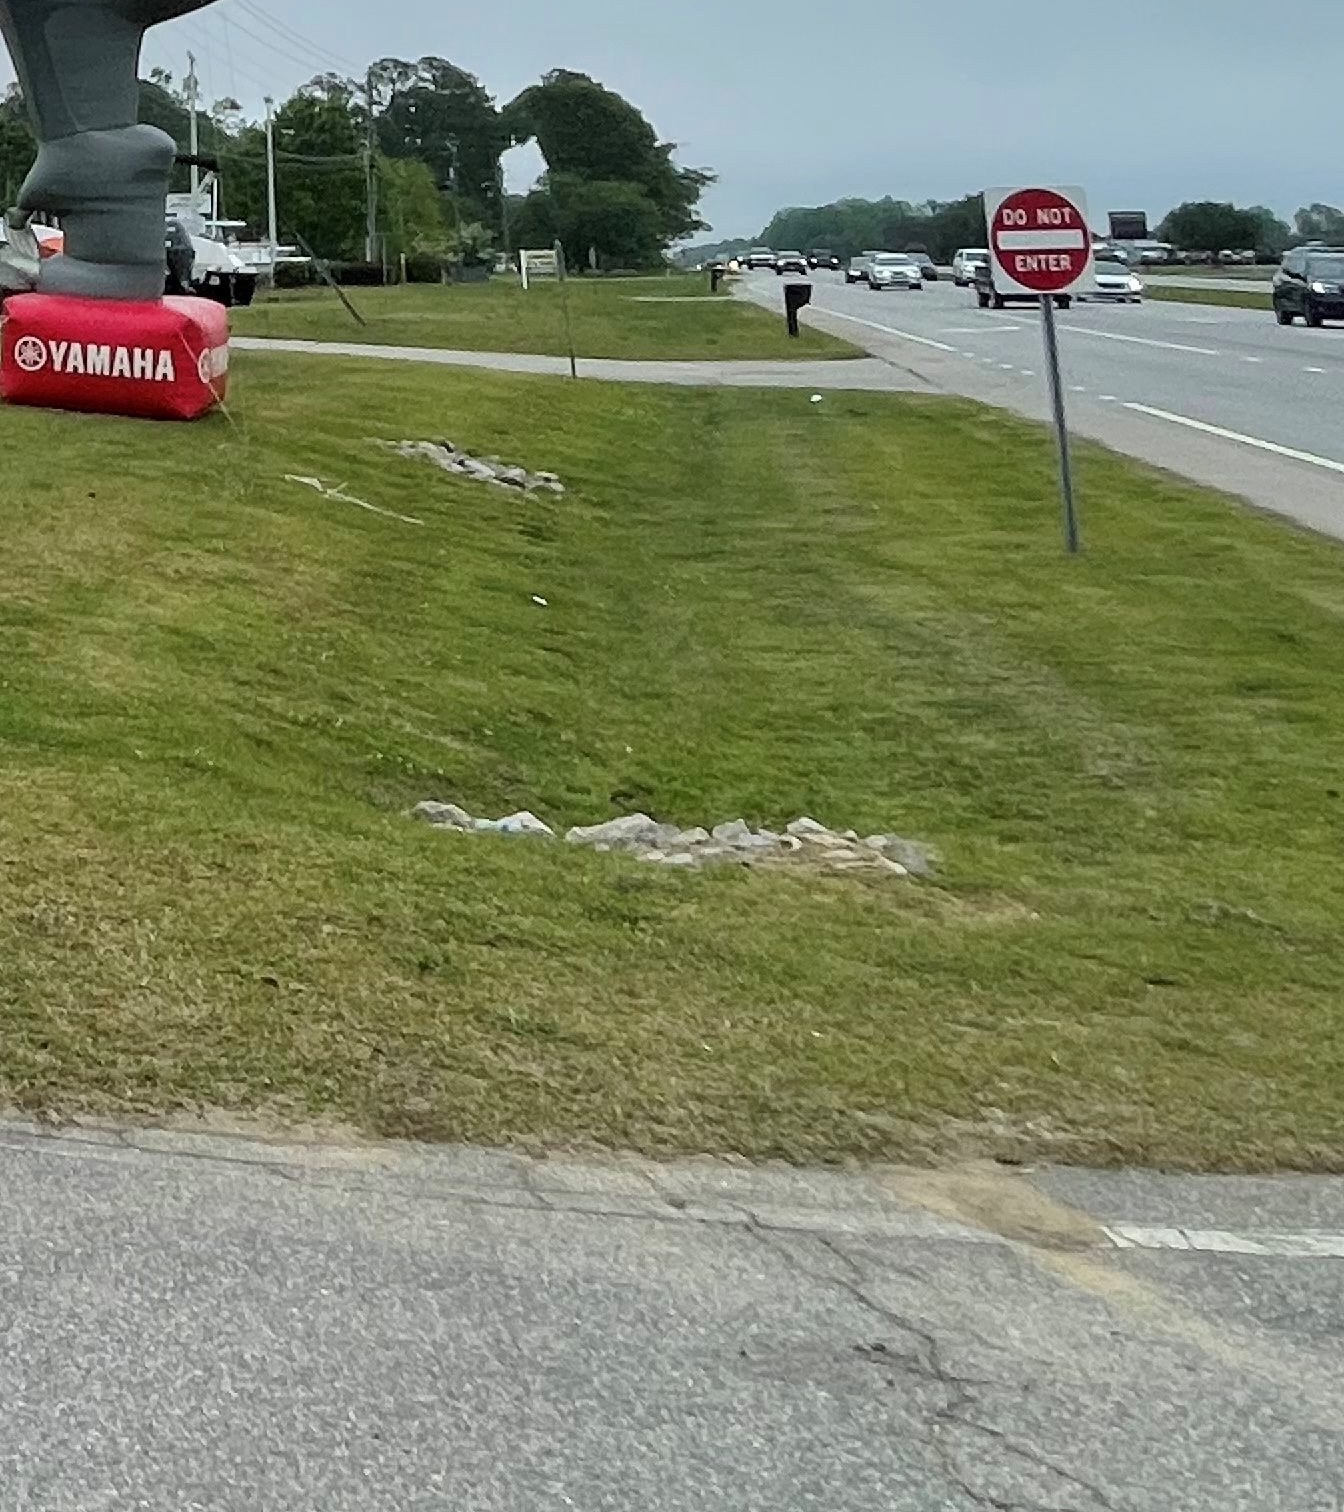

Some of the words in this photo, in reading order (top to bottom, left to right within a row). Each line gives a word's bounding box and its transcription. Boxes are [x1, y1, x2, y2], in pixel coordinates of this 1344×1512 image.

[1002, 207, 1027, 225] DO
[1036, 206, 1072, 225] NOT
[1014, 254, 1072, 272] ENTER
[48, 339, 175, 382] YAMAHA
